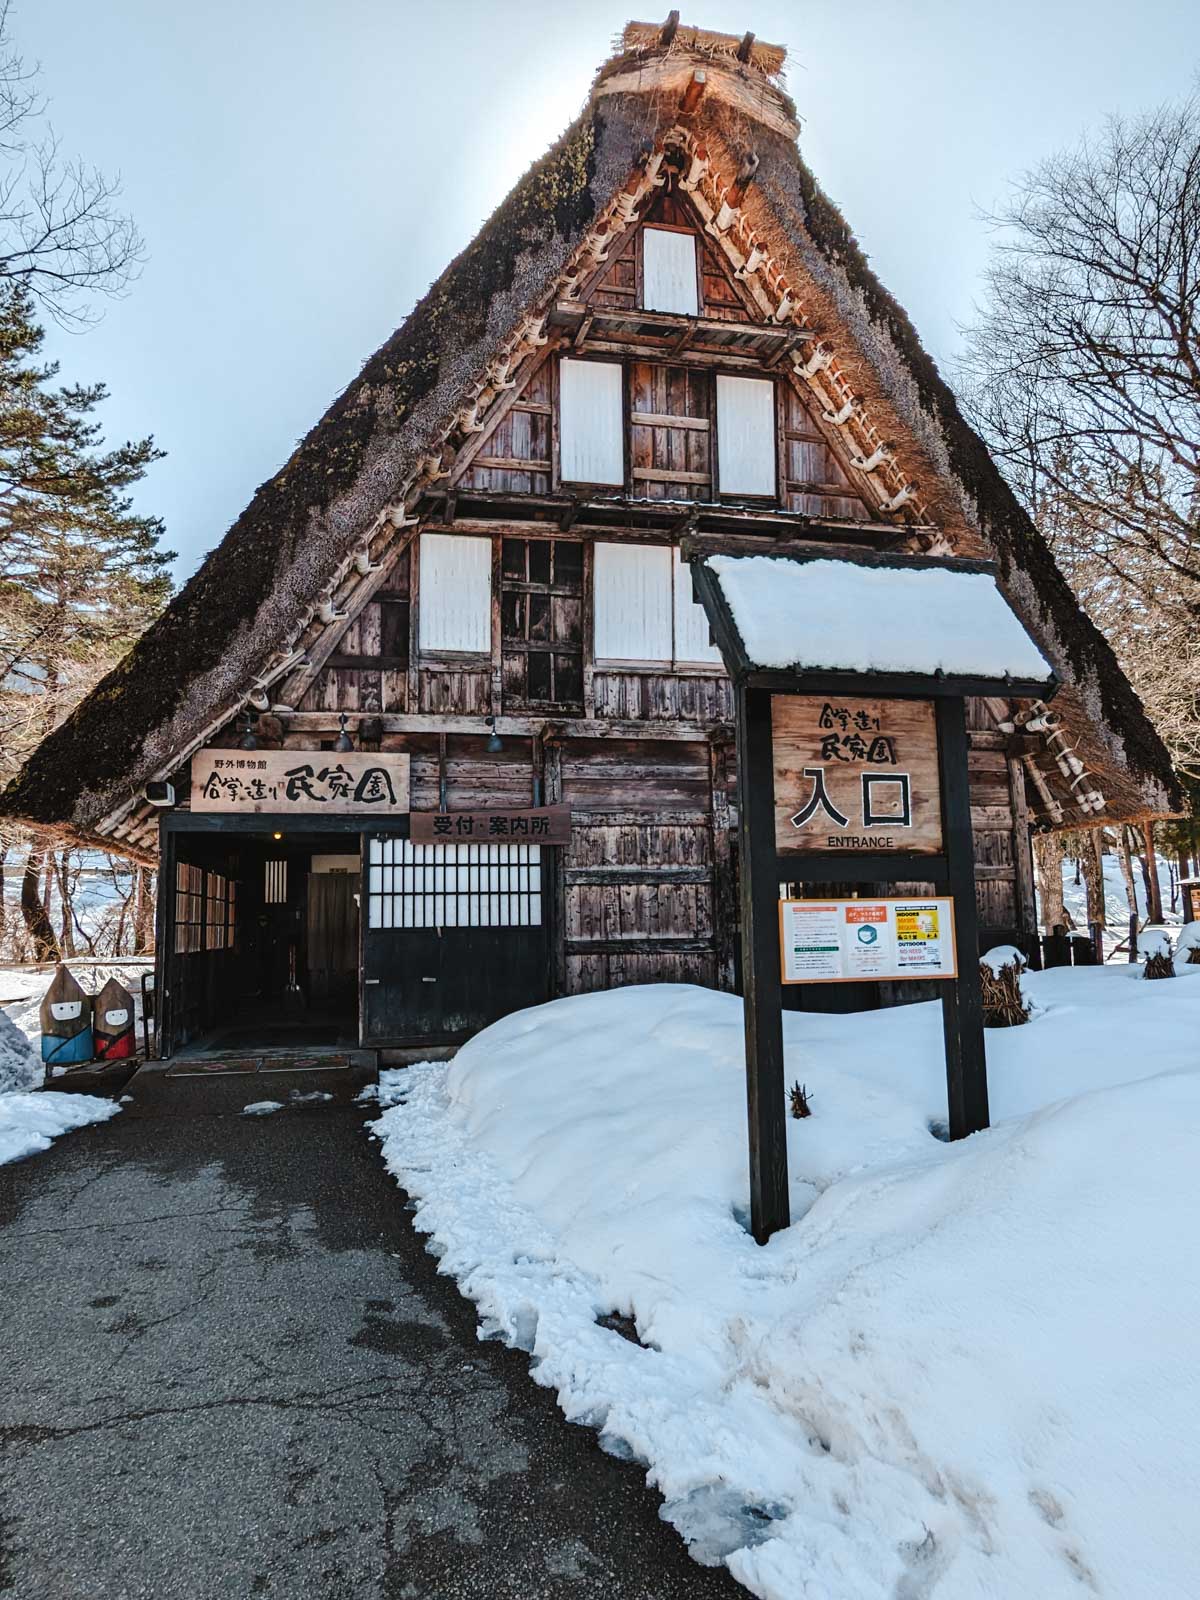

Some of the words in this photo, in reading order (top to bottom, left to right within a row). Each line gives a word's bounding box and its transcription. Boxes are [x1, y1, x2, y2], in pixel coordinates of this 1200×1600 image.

[820, 732, 897, 765] 民家園
[214, 759, 267, 770] 野外博物館
[791, 768, 912, 829] 入口
[433, 816, 550, 836] 受付・案内所
[828, 836, 894, 848] ENTRANCE
